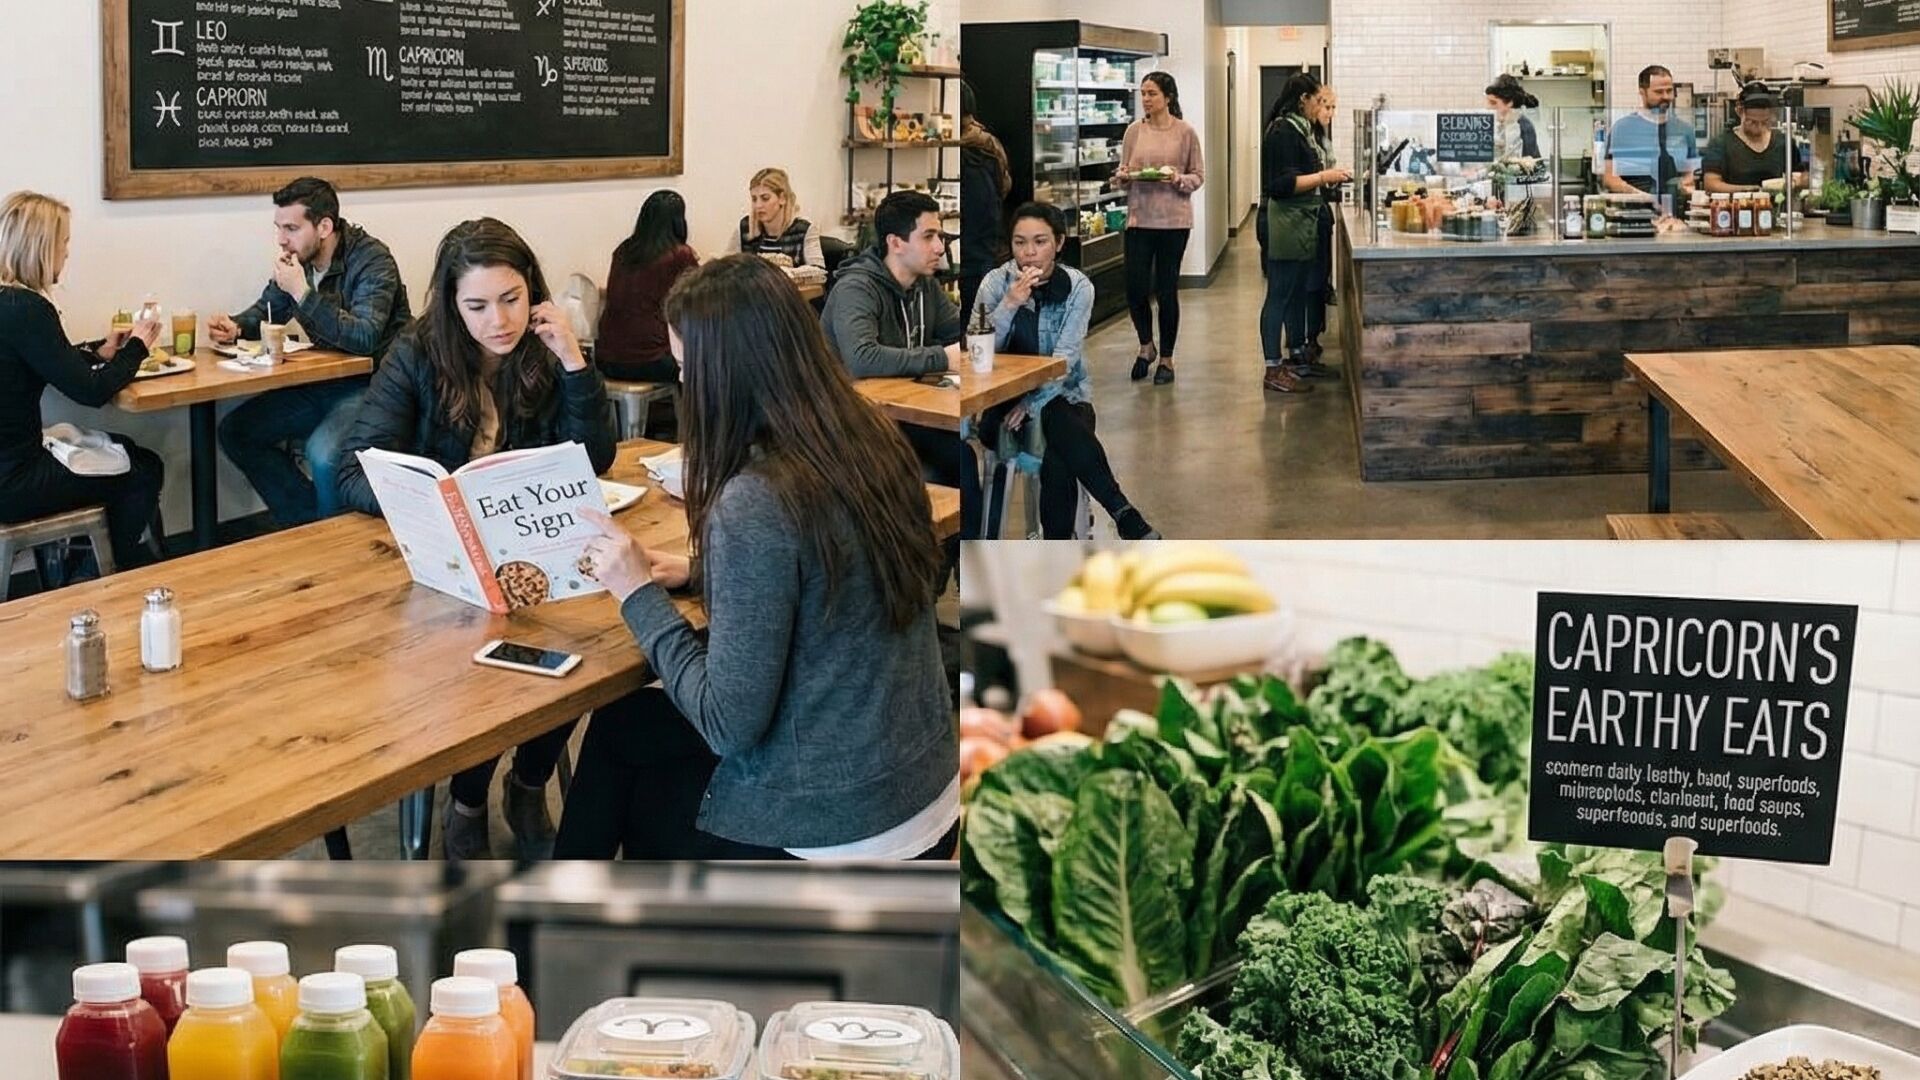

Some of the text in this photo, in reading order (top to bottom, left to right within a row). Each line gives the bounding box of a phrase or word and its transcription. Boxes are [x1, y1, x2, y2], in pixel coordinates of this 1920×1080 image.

[196, 20, 227, 40] LEO
[196, 86, 268, 106] CAPRORN
[476, 479, 588, 519] Eat Your
[514, 511, 575, 538] Sign
[1547, 611, 1840, 685] CAPRICORN'S
[1547, 686, 1830, 761] EARTHY EATS
[1607, 762, 1642, 785] daily
[1737, 774, 1820, 798] superfoods,
[1670, 811, 1697, 829] and
[1700, 816, 1782, 836] superfoods.
